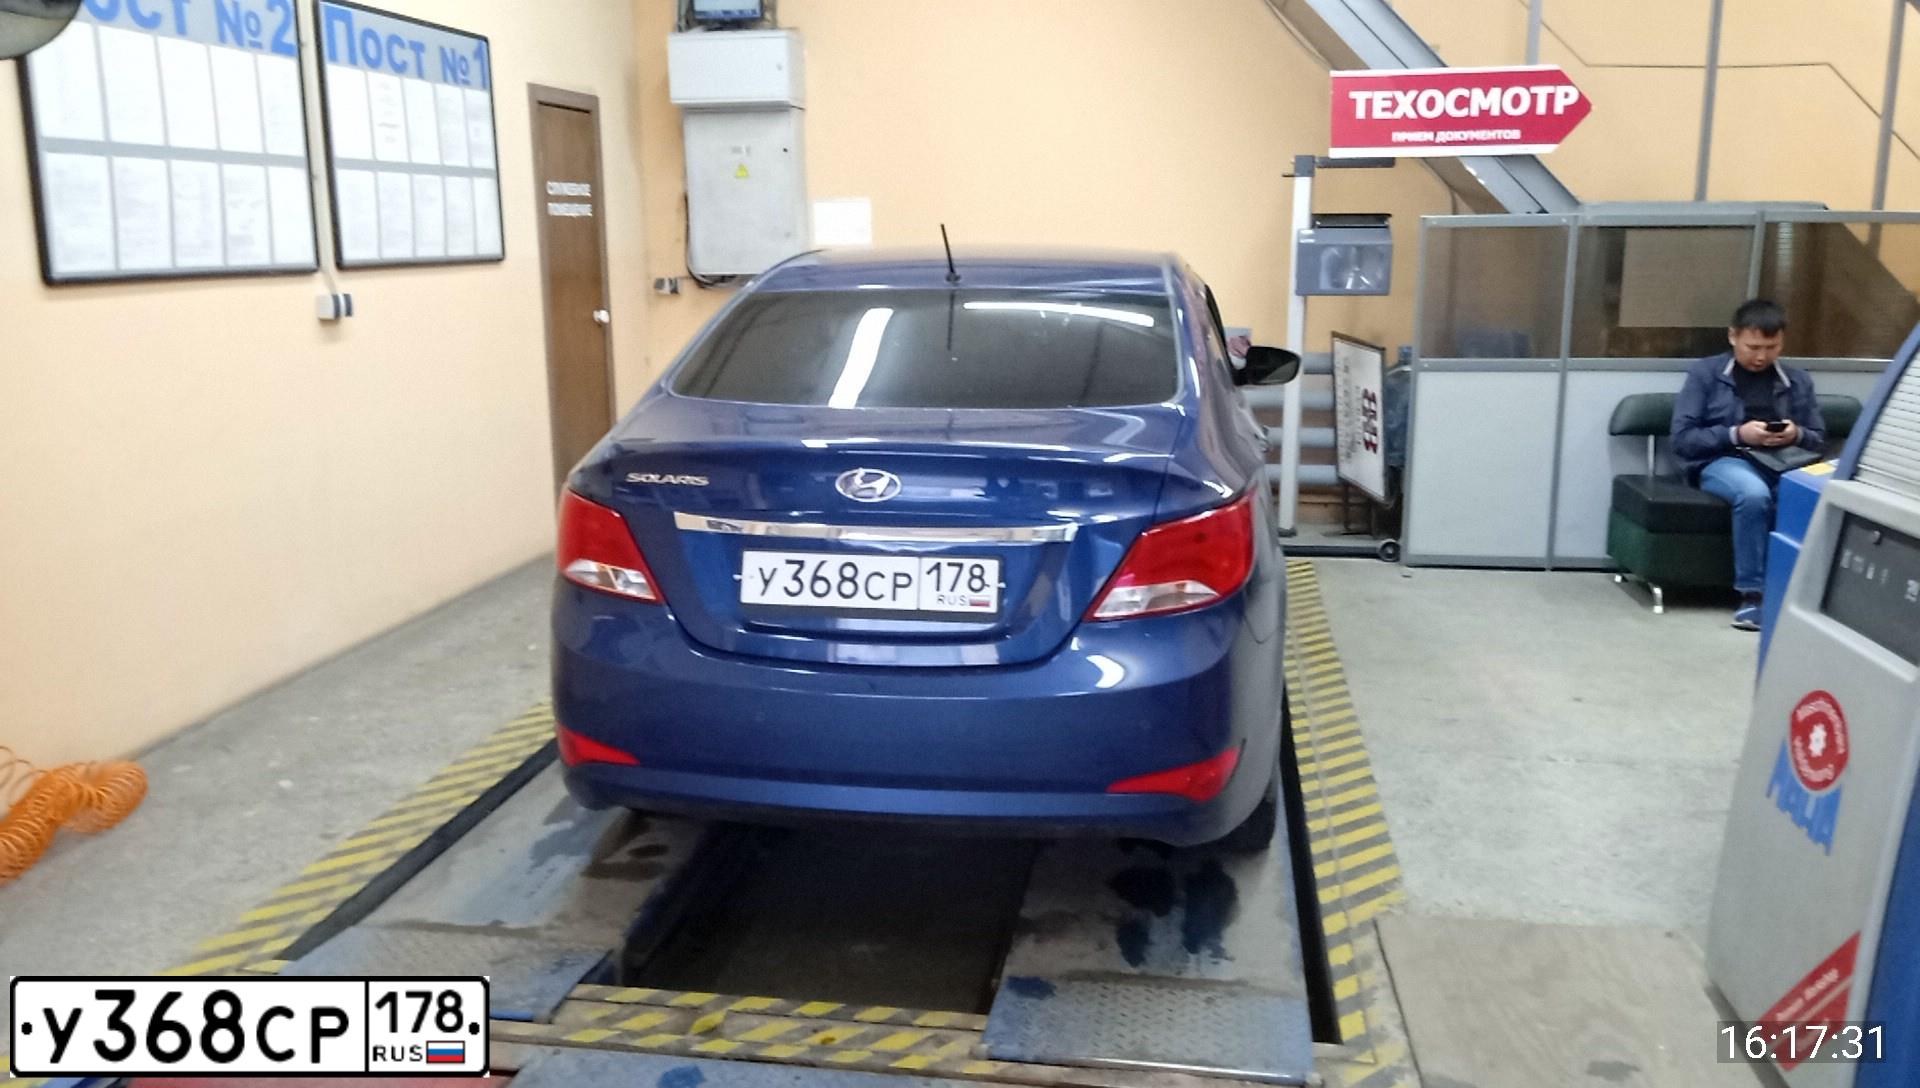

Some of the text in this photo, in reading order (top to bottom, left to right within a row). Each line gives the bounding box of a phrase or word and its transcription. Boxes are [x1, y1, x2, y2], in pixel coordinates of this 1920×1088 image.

[323, 5, 426, 79] Пост
[1349, 85, 1580, 120] ТЕХОСМОТР
[1435, 129, 1521, 143] ДОКУМЕНТОВ
[625, 472, 710, 486] SOLARIS
[758, 559, 986, 601] У368СР 178
[937, 595, 968, 606] RUS
